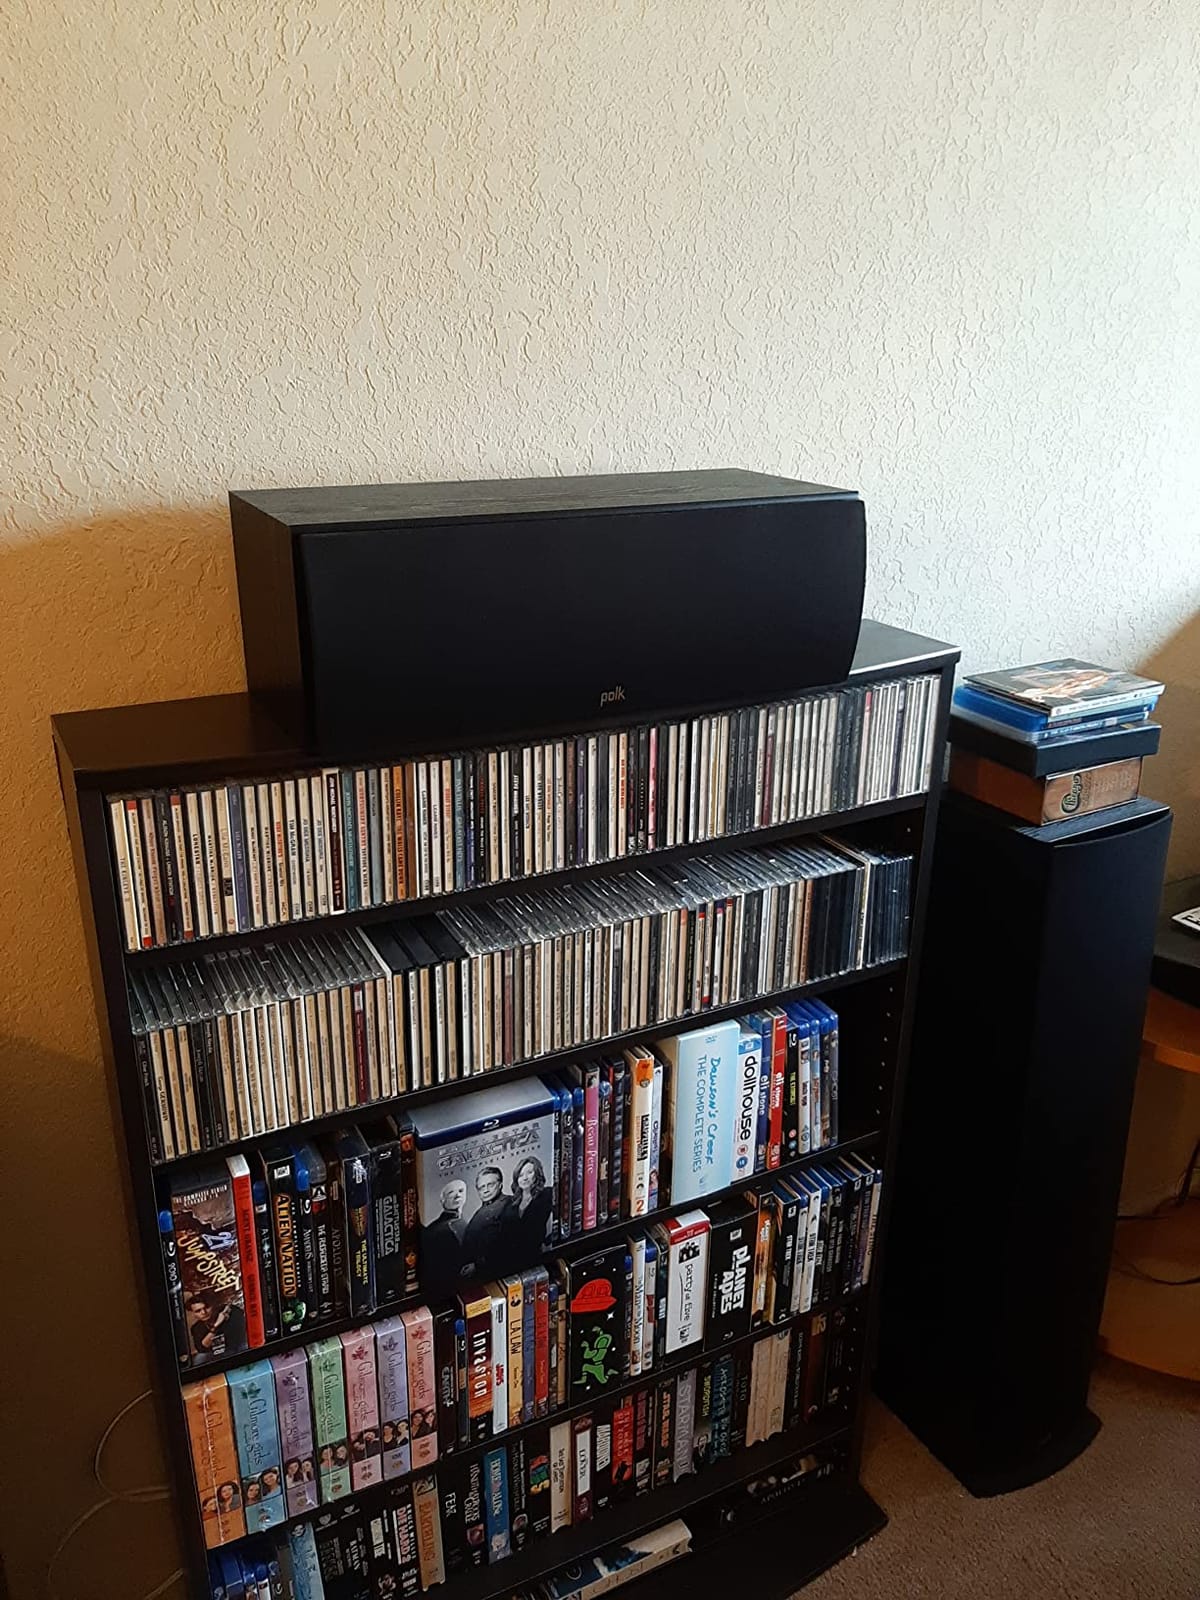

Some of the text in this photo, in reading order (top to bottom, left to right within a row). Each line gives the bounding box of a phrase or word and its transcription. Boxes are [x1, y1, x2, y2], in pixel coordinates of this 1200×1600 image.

[600, 685, 626, 708] polk
[193, 833, 201, 865] LONESTAR
[159, 1091, 169, 1121] GERSHWIN
[740, 1055, 758, 1141] dollhouse
[758, 1074, 770, 1116] eli stone
[774, 1071, 785, 1108] eli stone
[692, 1055, 708, 1173] THE COMPLETE SERIES
[437, 1131, 540, 1171] GALACTICA
[201, 1231, 236, 1250] 21
[277, 1195, 297, 1297] ALIEN NATION
[331, 1228, 343, 1265] APOLLO
[382, 1195, 395, 1256] GALACTICA
[169, 1262, 178, 1281] 2010
[176, 1234, 241, 1293] JUMP STREET
[354, 1249, 363, 1279] TRILOGY
[360, 1239, 369, 1286] THE ULTIMATE
[784, 1248, 792, 1261] TREK
[683, 1263, 694, 1293] party
[718, 1270, 735, 1316] APES
[731, 1244, 751, 1310] PLANET
[633, 1285, 644, 1345] Man Moon
[683, 1302, 693, 1321] five
[471, 1329, 491, 1398] invasion
[510, 1335, 521, 1355] LAW
[384, 1351, 404, 1412] Gilmore girls
[412, 1340, 432, 1400] Gilmore girls
[286, 1386, 308, 1448] Gilmore girls
[321, 1374, 340, 1435] Gilmore girls
[674, 1383, 691, 1464] STARMAN
[246, 1398, 270, 1466] Gilmore girls
[396, 1506, 409, 1523] DIE
[444, 1491, 457, 1519] FEAR
[398, 1525, 411, 1556] HARD
